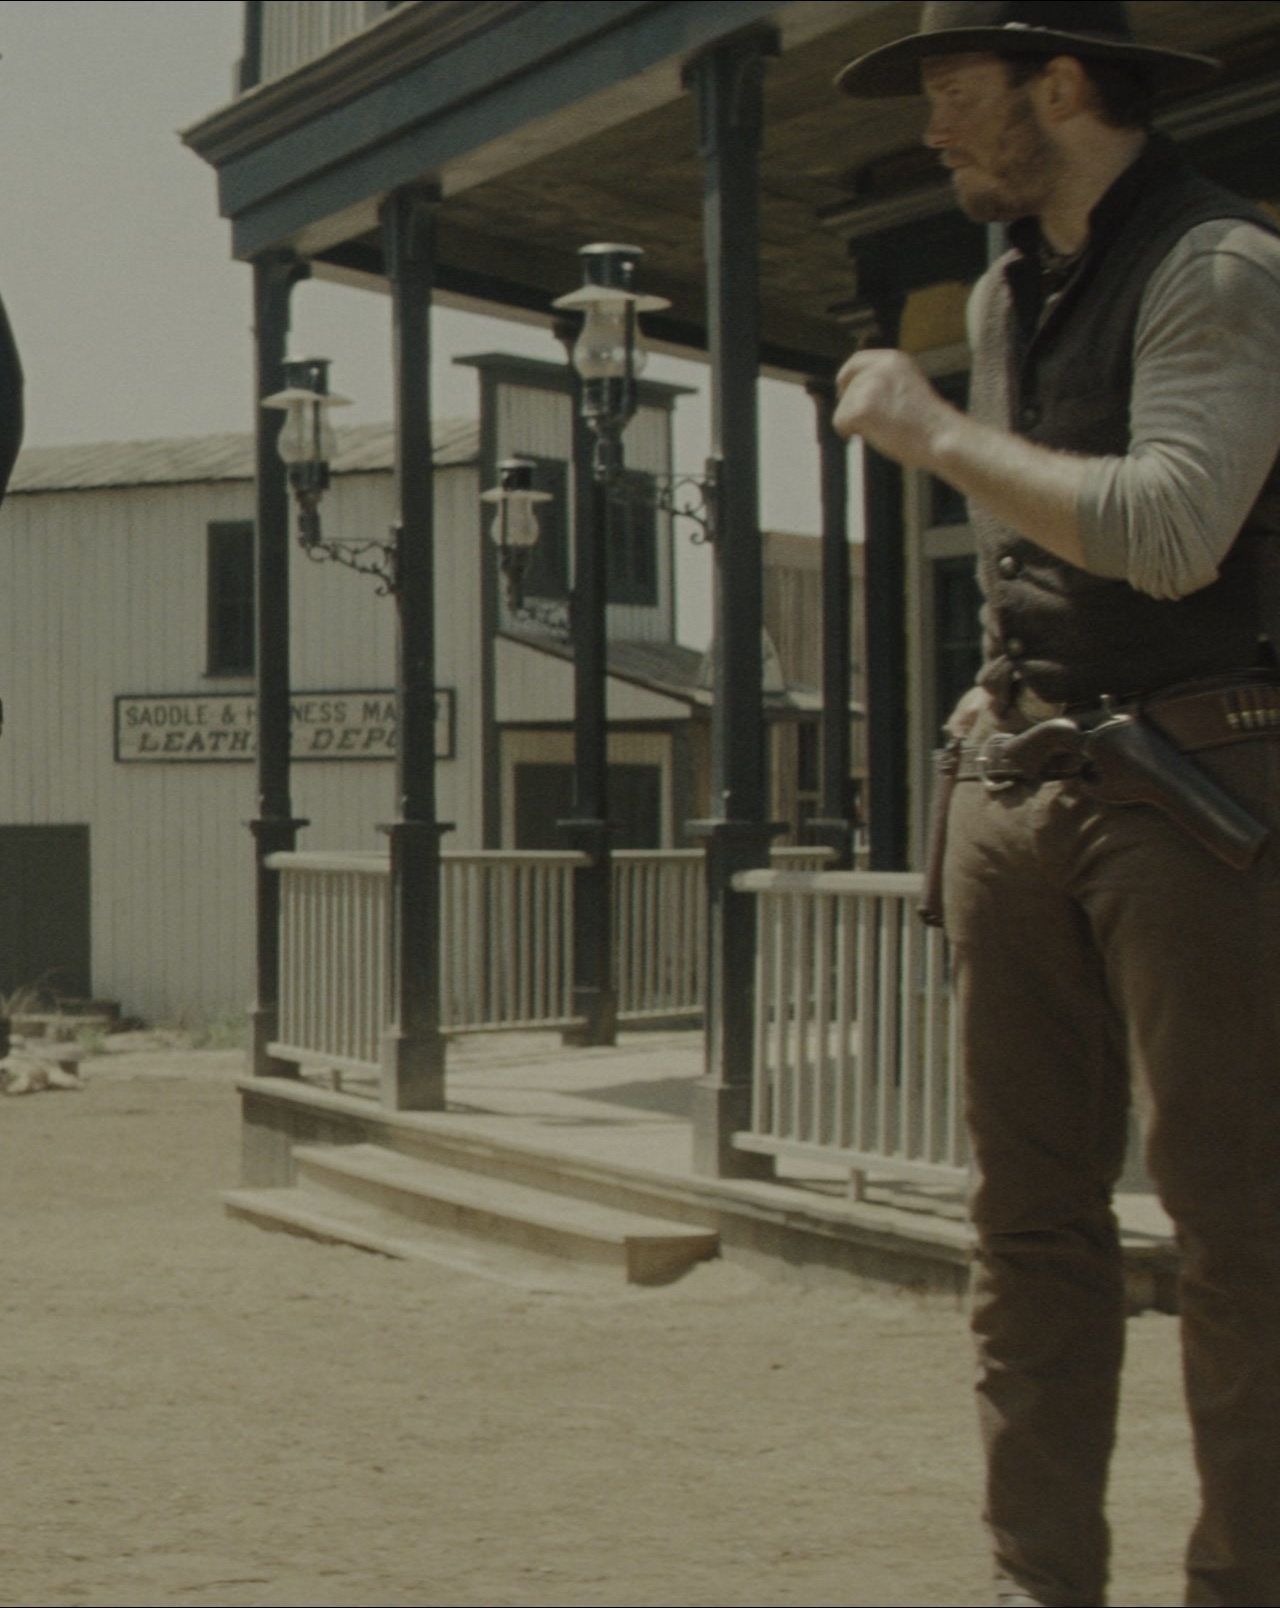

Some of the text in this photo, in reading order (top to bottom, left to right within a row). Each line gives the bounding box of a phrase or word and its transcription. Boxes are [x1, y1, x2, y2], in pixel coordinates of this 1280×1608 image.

[125, 704, 209, 728] SADDLE
[220, 703, 236, 724] &
[246, 700, 348, 725] HNESS
[139, 730, 292, 753] LEATH
